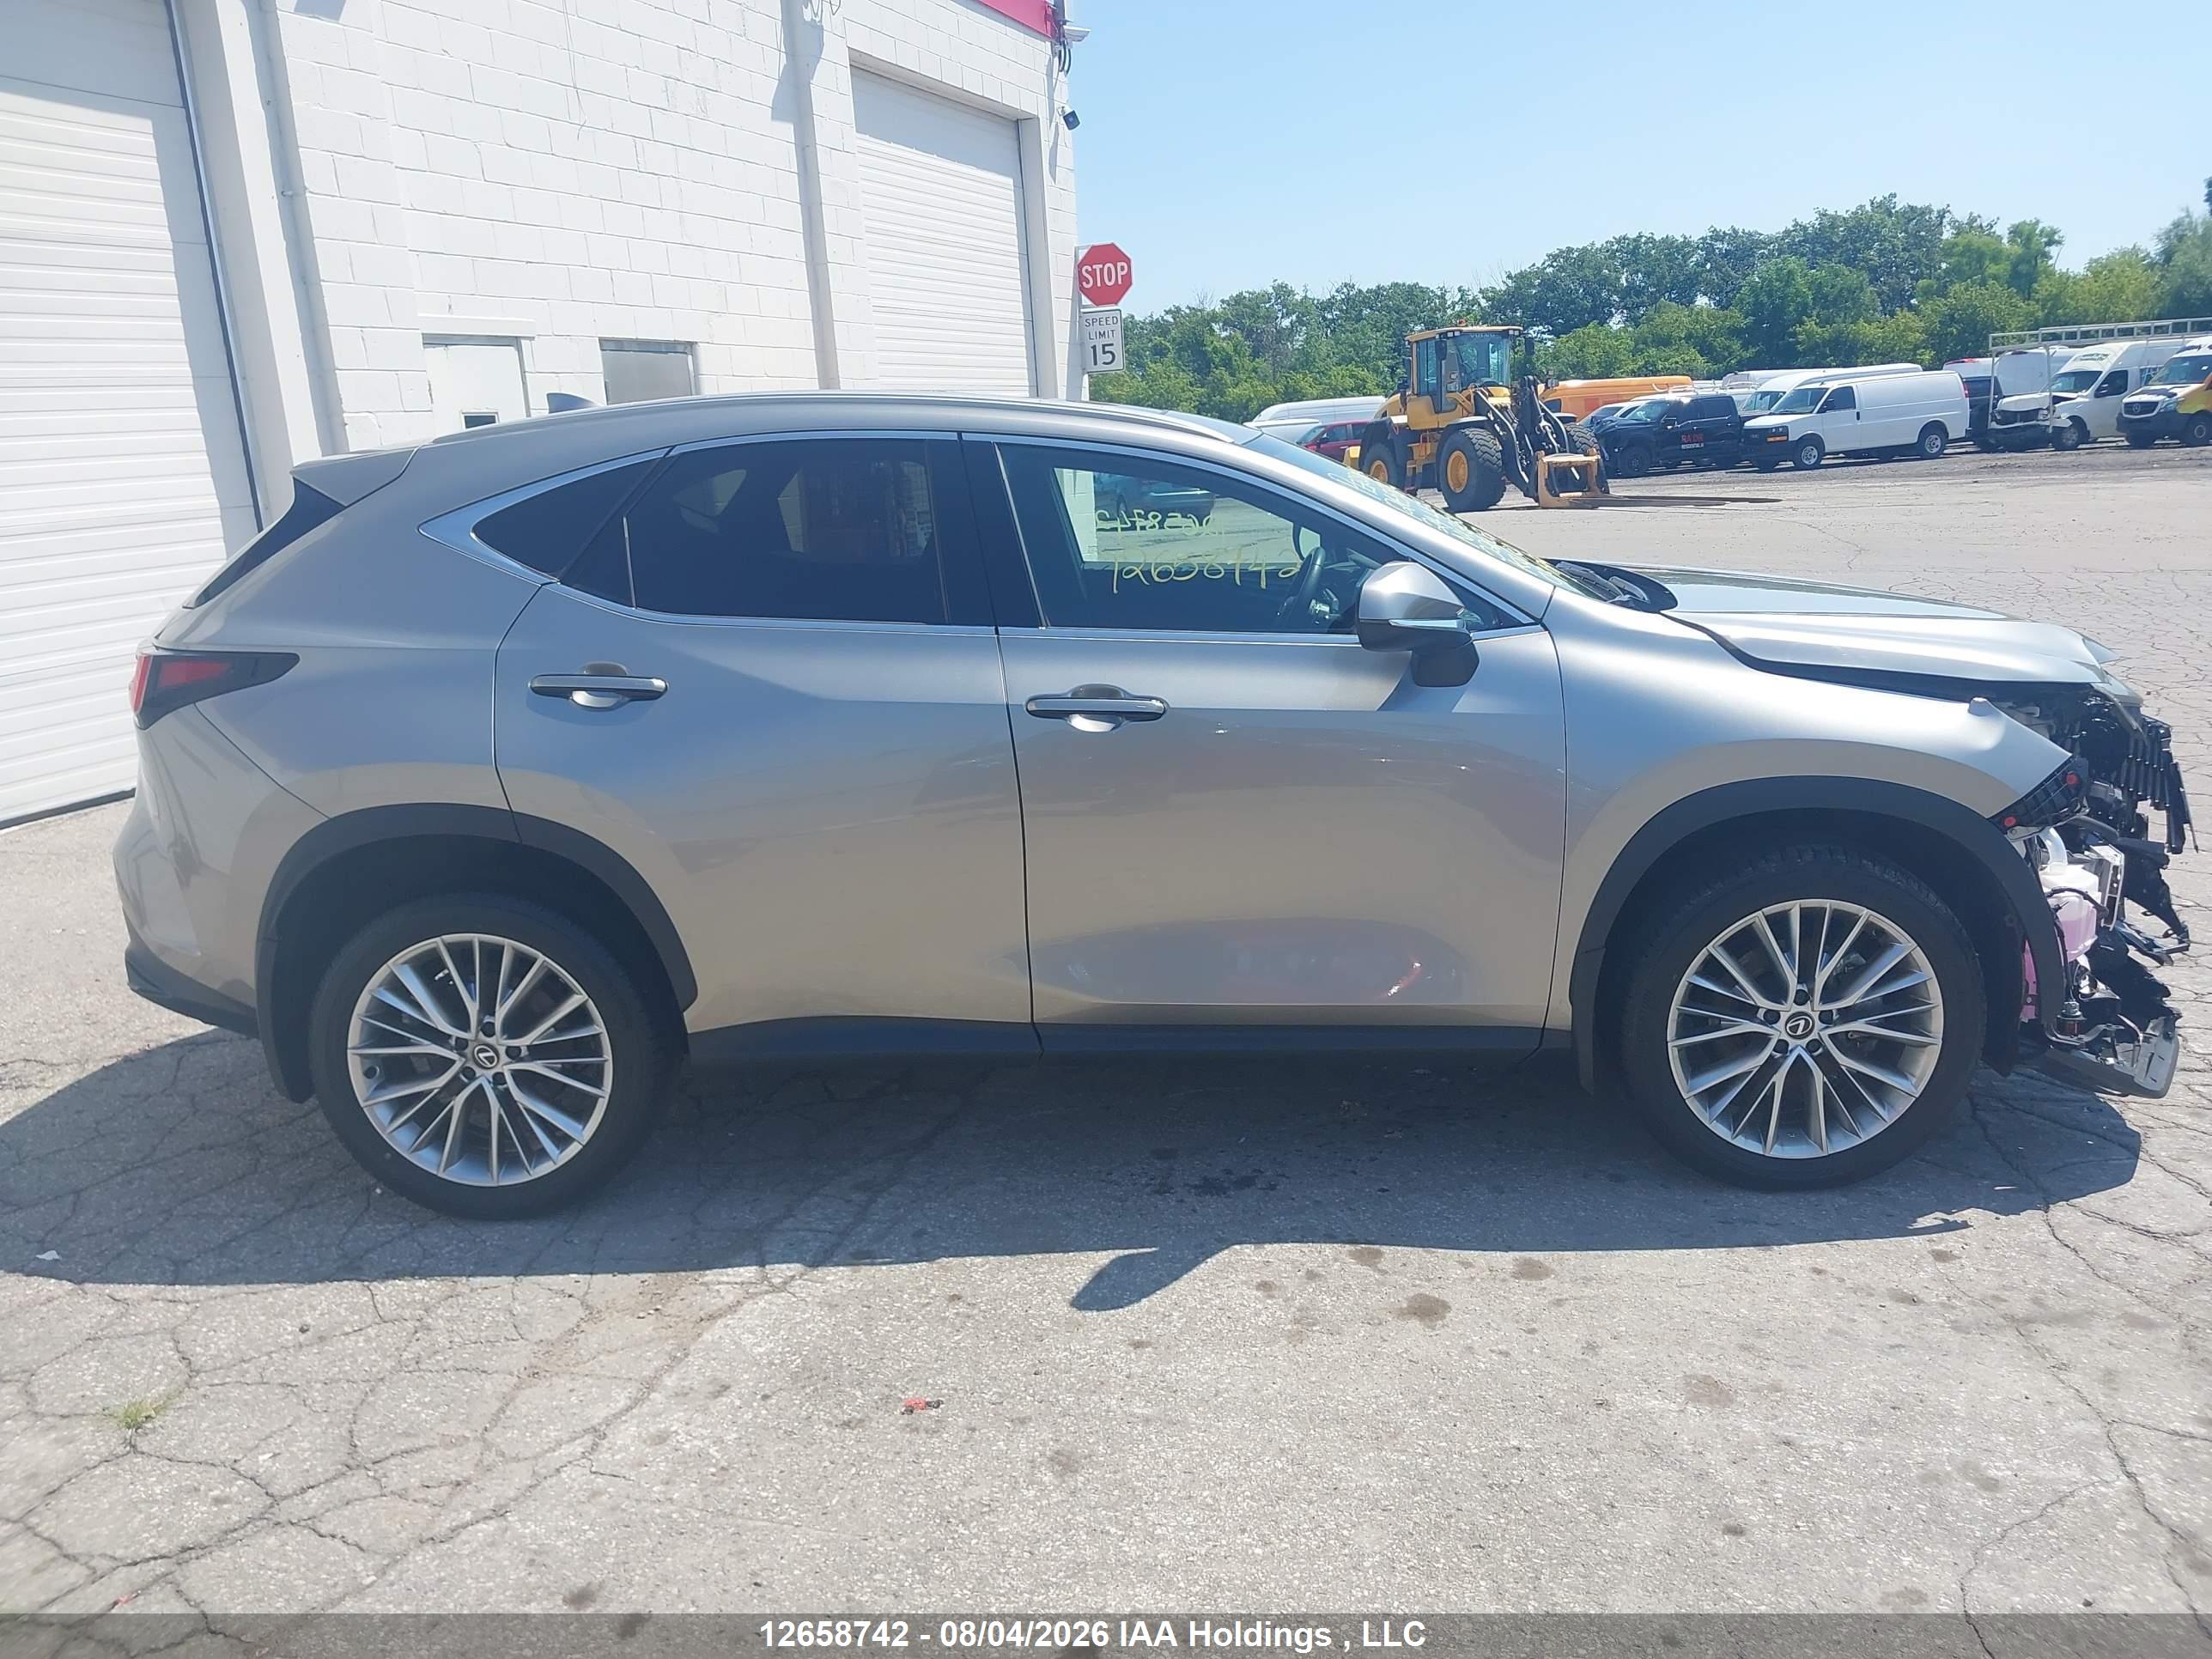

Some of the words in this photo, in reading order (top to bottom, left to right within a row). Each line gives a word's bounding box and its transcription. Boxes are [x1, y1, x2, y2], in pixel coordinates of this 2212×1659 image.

[1081, 261, 1127, 289] STOP
[1085, 316, 1118, 327] SPEED
[1088, 330, 1115, 341] LIMIT
[1091, 343, 1116, 366] 15
